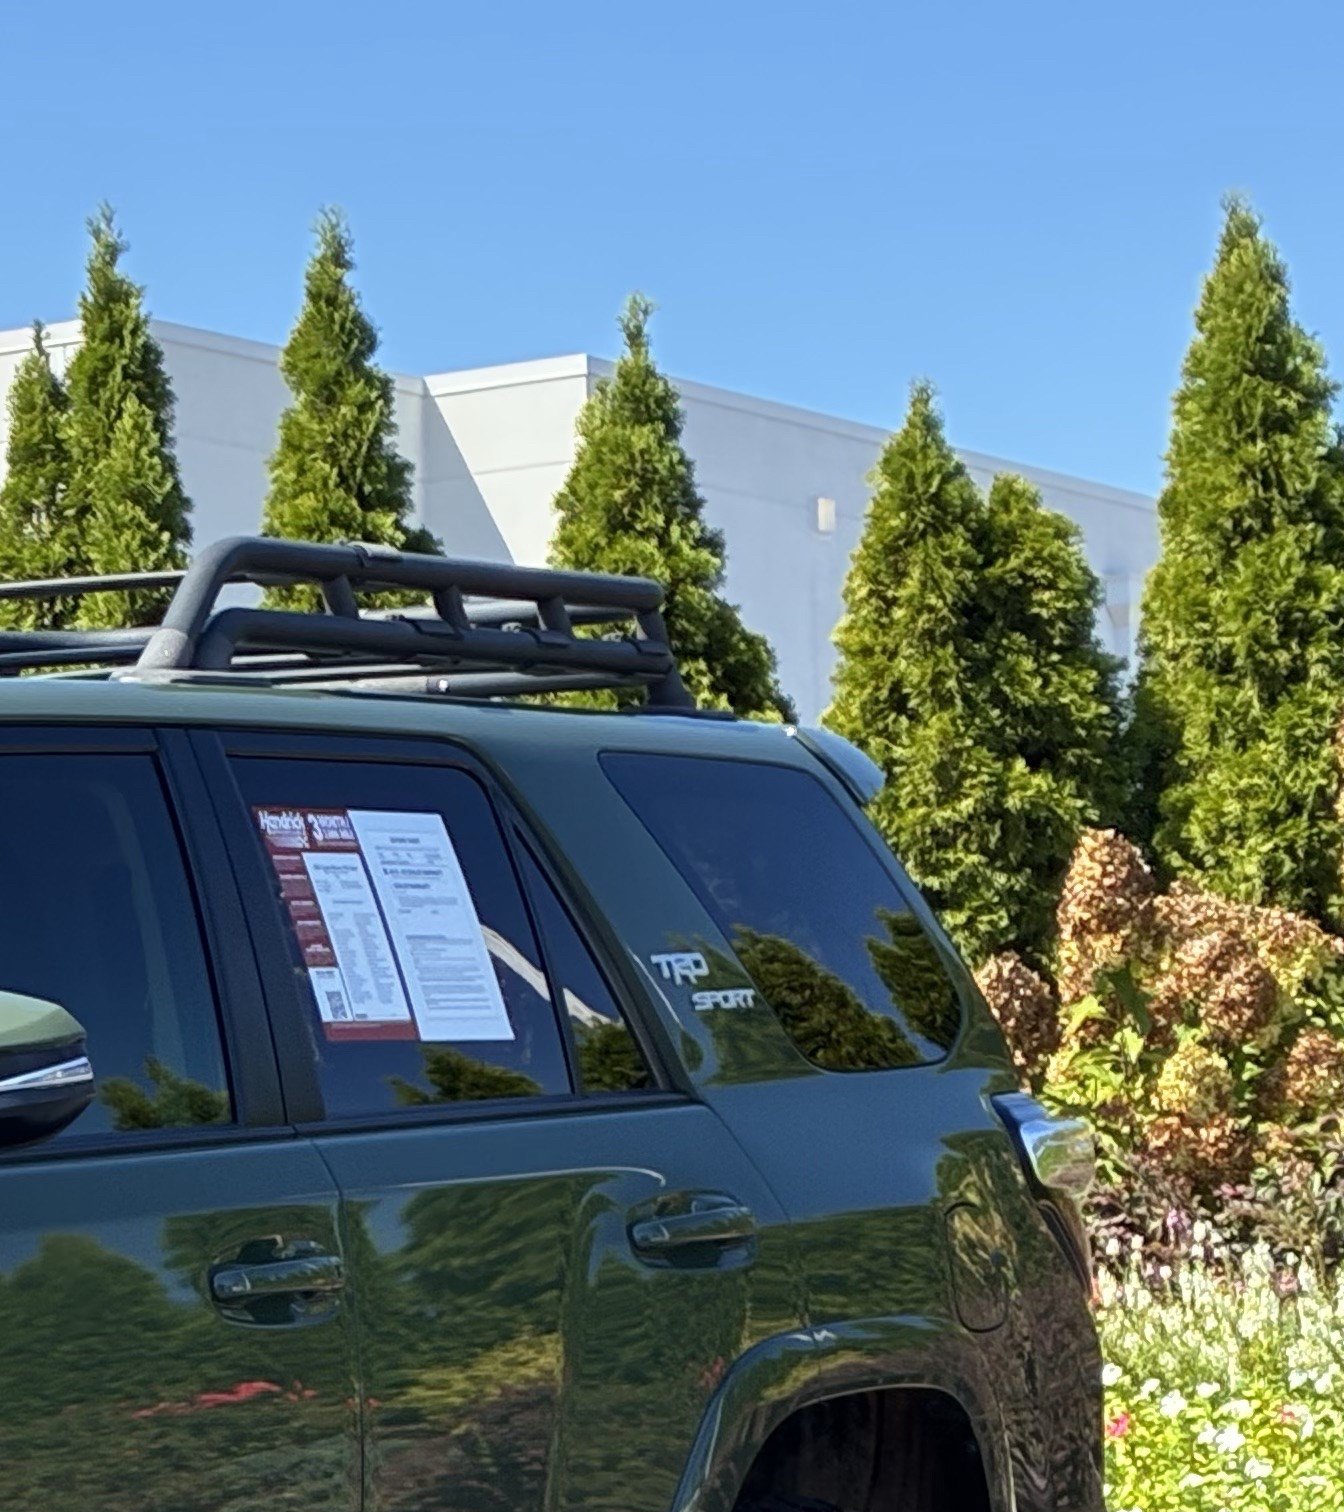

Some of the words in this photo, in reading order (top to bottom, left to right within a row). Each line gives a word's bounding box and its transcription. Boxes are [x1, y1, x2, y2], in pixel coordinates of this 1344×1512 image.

[258, 810, 306, 836] Hendrick
[651, 952, 709, 985] TRD
[692, 989, 755, 1010] SPORT
